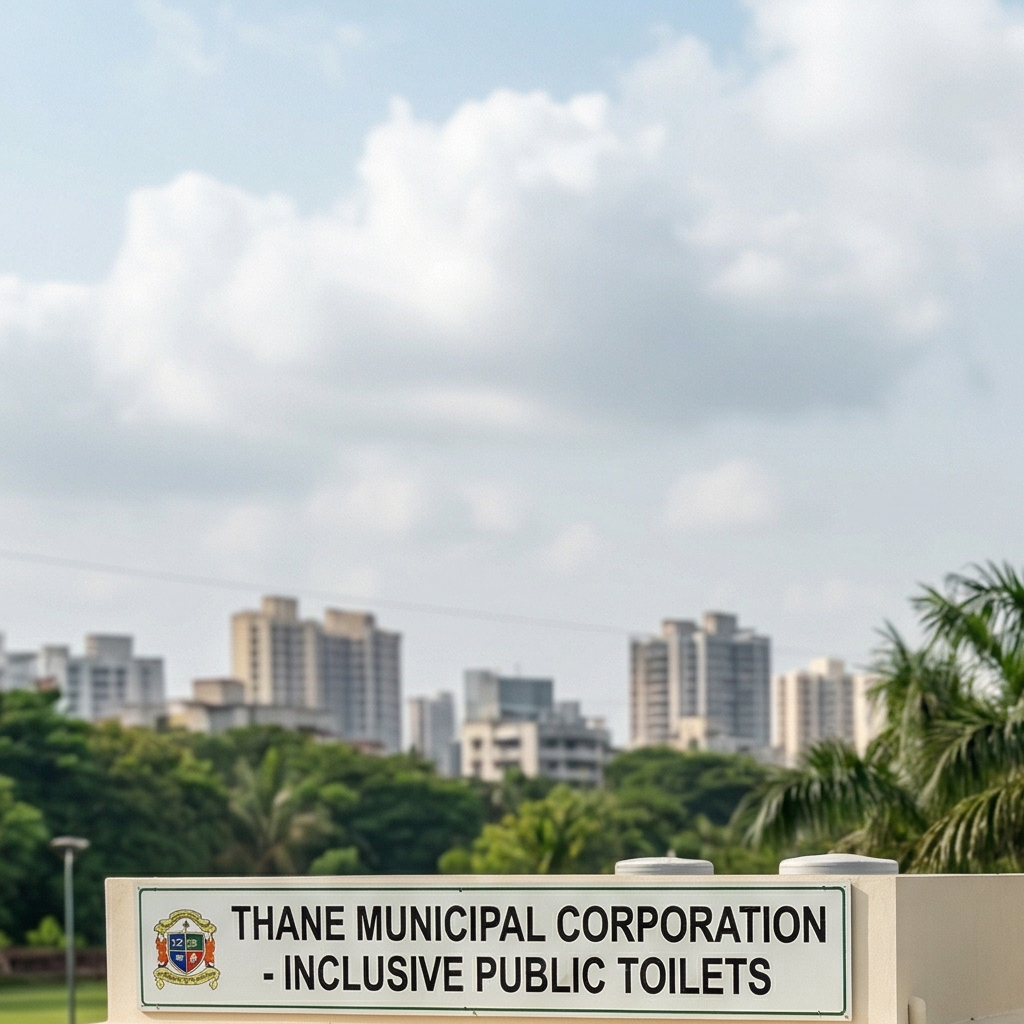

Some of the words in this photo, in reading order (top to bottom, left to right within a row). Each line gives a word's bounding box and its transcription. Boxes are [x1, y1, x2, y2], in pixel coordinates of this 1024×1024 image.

[232, 905, 345, 941] THANE
[356, 905, 546, 942] MUNICIPAL
[556, 905, 825, 943] CORPORATION
[264, 973, 273, 981] -
[285, 955, 464, 992] INCLUSIVE
[476, 956, 606, 994] PUBLIC
[618, 957, 772, 995] TOILETS
